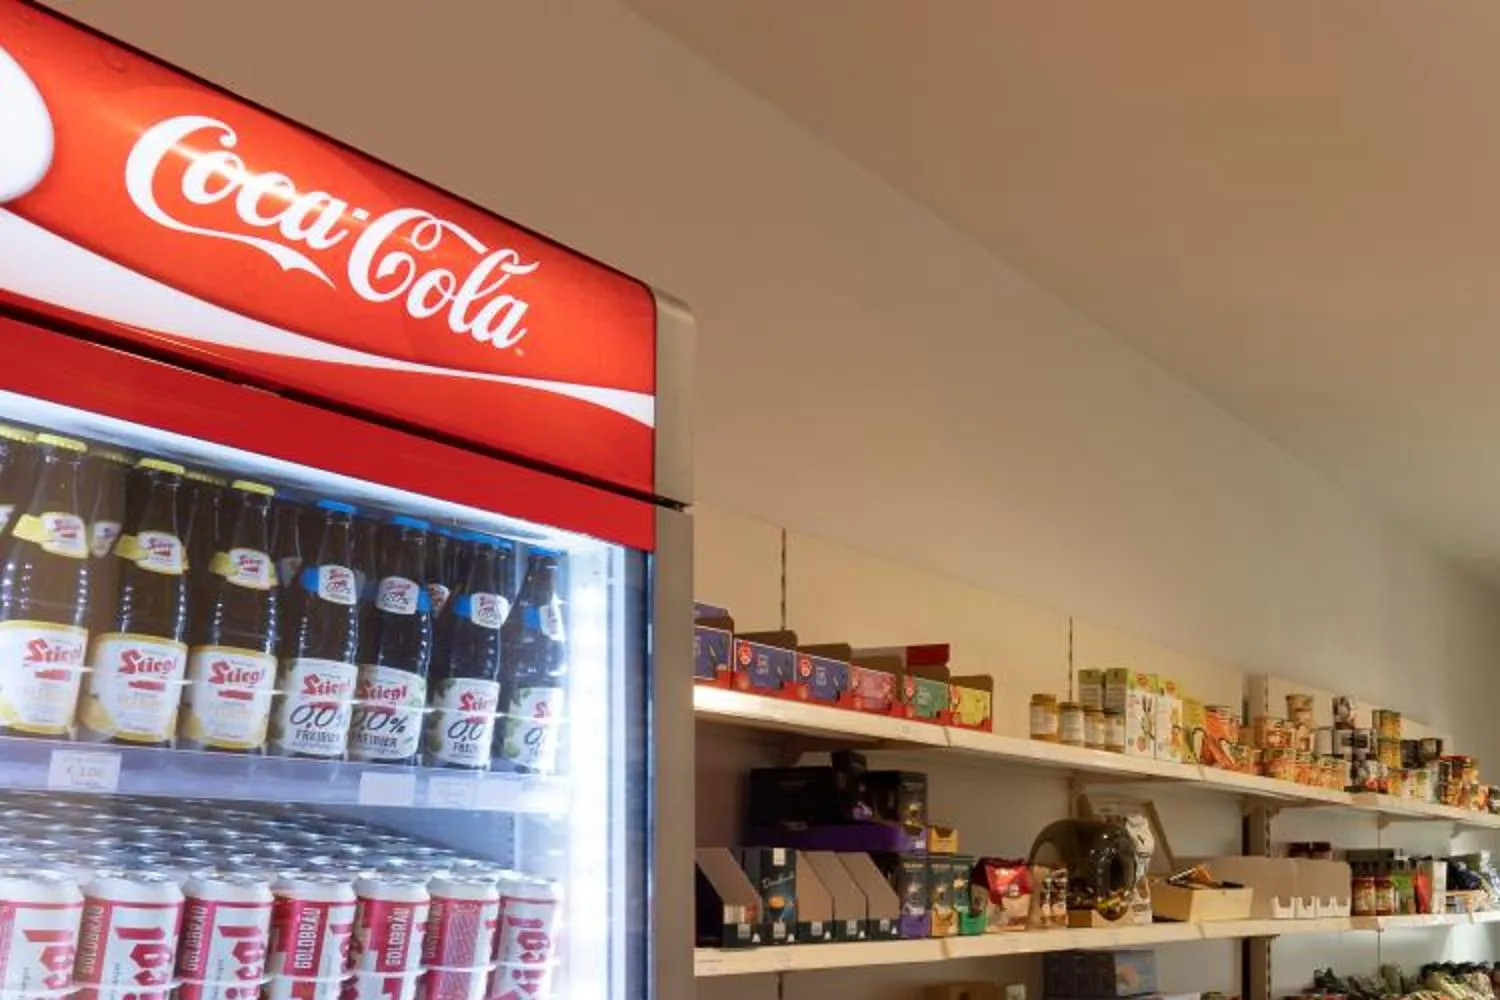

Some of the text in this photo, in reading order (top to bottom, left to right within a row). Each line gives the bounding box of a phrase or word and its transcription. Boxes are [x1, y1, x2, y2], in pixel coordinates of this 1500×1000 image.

[125, 114, 541, 350] Coca-Cola
[118, 648, 177, 676] Stiegl
[208, 658, 266, 686] Stiegl
